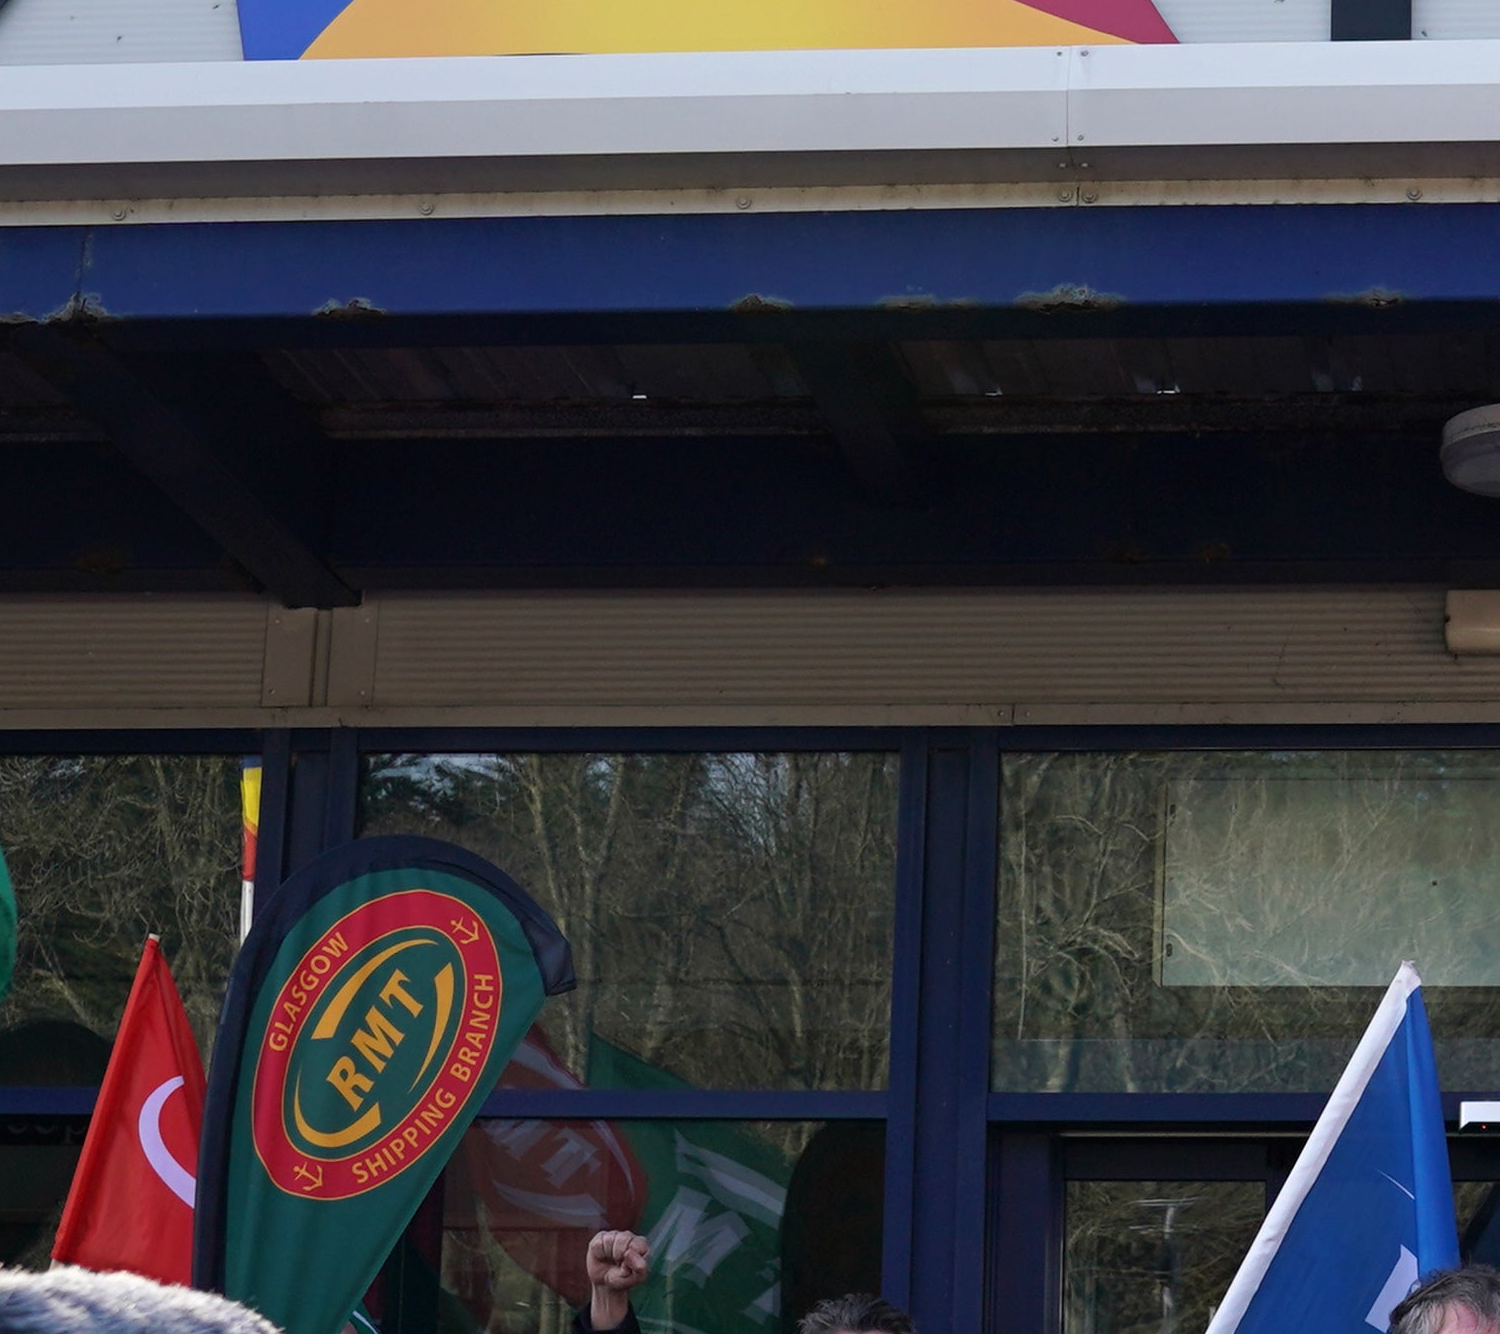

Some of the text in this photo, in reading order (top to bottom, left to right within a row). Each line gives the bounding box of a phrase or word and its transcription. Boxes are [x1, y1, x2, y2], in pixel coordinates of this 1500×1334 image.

[269, 931, 350, 1052] GLASGOW
[326, 968, 425, 1112] RMT
[351, 973, 494, 1184] SHIPPING BRANCH
